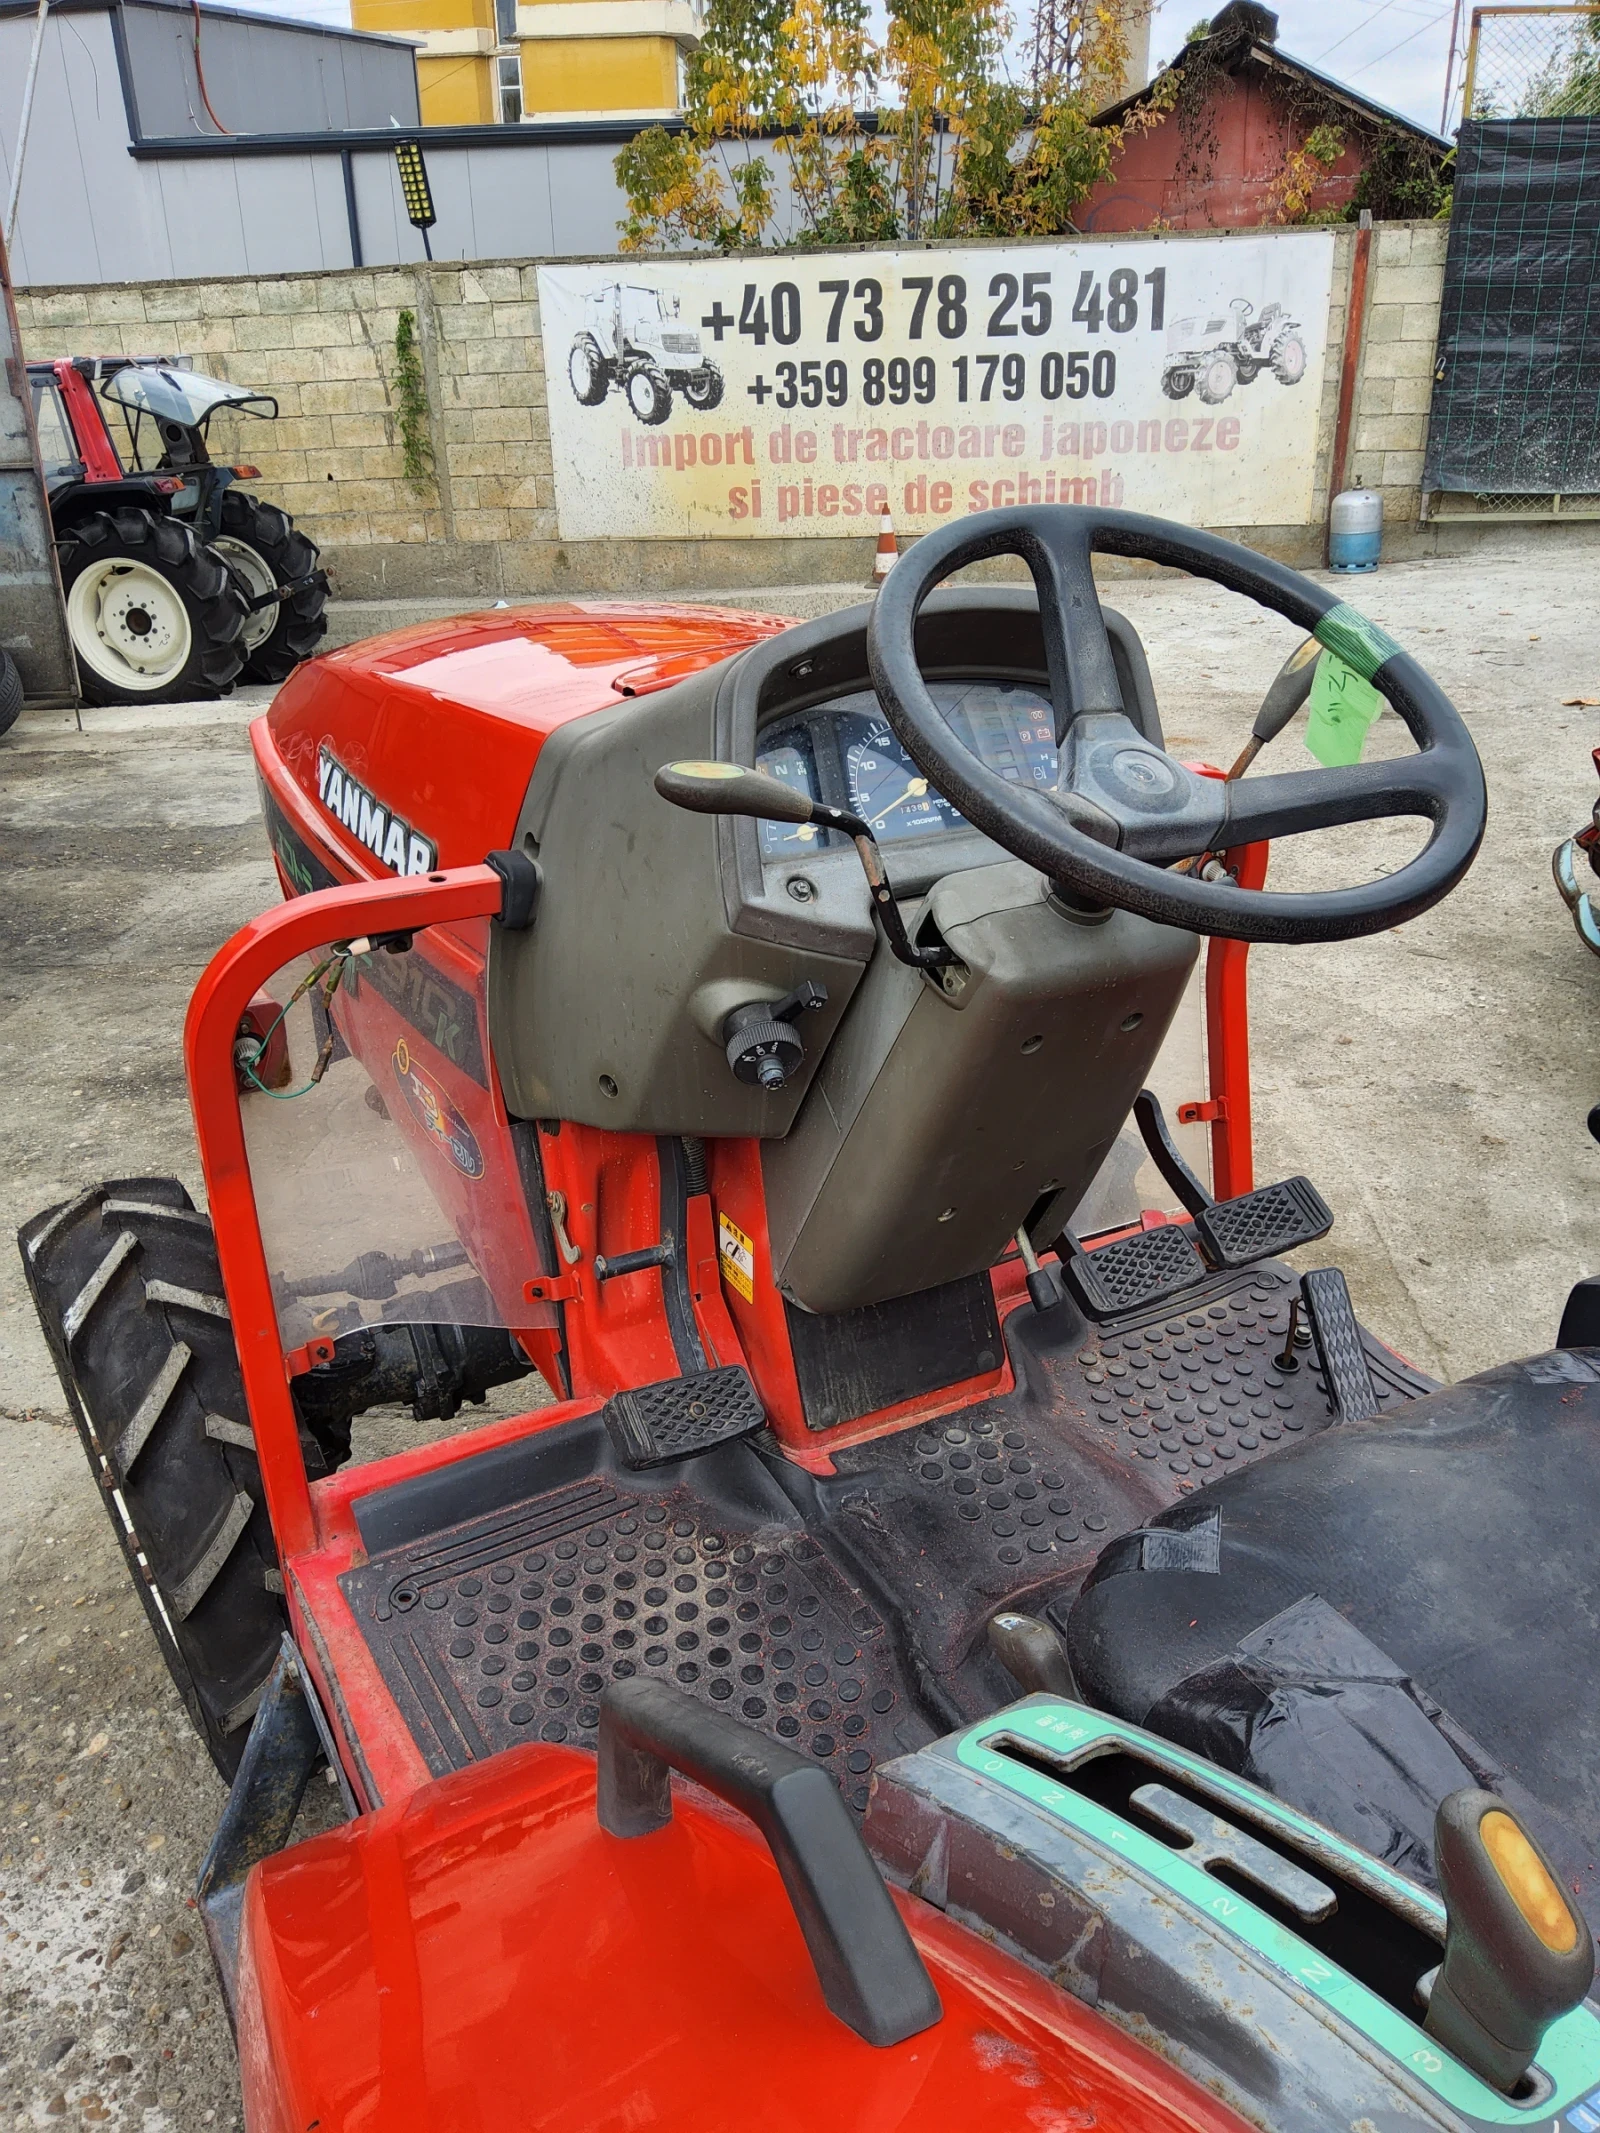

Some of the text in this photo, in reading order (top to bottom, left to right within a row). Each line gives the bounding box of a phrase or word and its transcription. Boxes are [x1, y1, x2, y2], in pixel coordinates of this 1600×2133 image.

[702, 267, 1166, 345] +40 73 78 25 481
[747, 350, 1117, 408] +359 899 179 050
[621, 415, 1241, 471] Import de tractoare japoneze
[728, 468, 1125, 522] si piese de schimb
[874, 736, 891, 747] 15
[774, 764, 788, 775] N
[860, 760, 877, 771] 10
[860, 793, 870, 802] 5
[318, 750, 435, 878] YANMAR
[875, 820, 885, 829] 0
[1212, 1897, 1239, 1916] 2
[1301, 1961, 1333, 1985] N
[1412, 2050, 1442, 2073] 3
